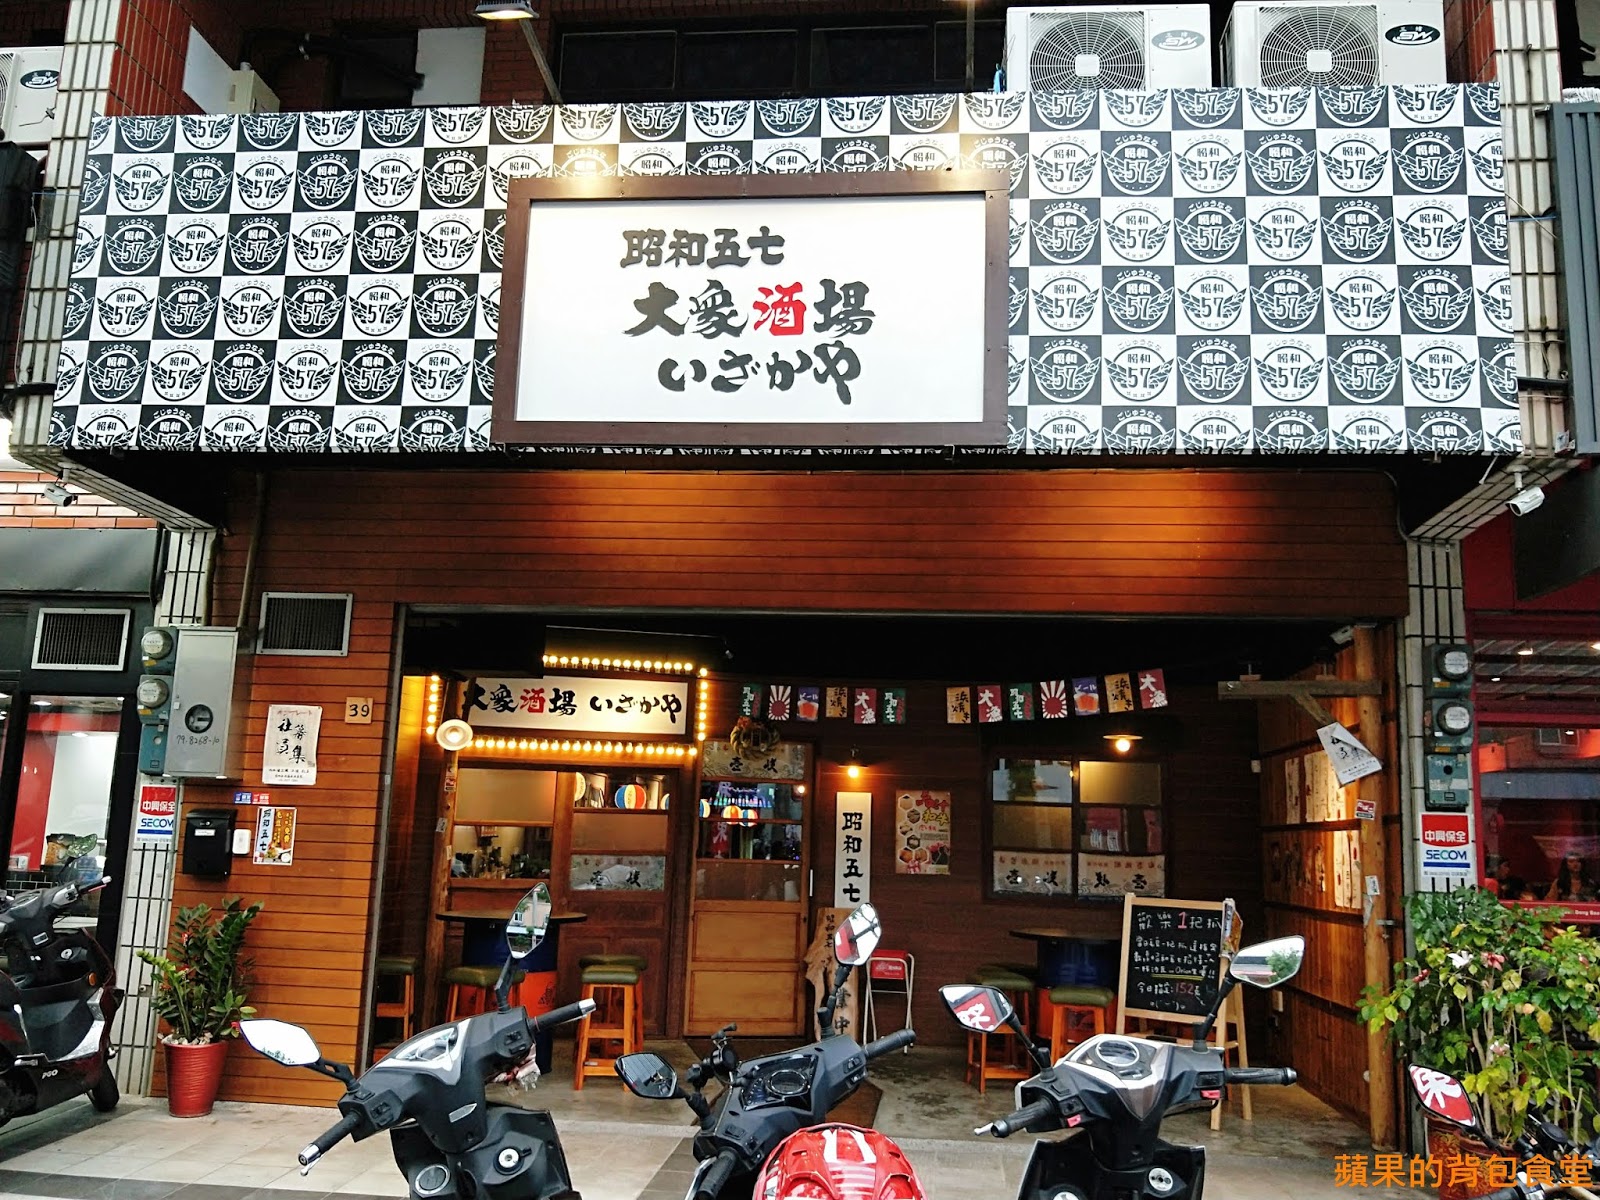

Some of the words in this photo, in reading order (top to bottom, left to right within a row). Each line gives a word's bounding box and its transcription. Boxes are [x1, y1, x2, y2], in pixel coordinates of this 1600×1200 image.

[643, 107, 665, 128] 57
[710, 107, 731, 126] 57
[777, 102, 799, 124] 57
[845, 101, 867, 121] 57
[914, 98, 936, 120] 57
[983, 98, 1005, 118] 57
[512, 110, 533, 131] 57
[577, 110, 598, 129] 57
[1054, 149, 1076, 159] 昭和
[1125, 148, 1148, 158] 昭和
[1197, 148, 1220, 157] 昭和
[1269, 146, 1293, 157] 昭和
[1343, 147, 1366, 157] 昭和
[1416, 145, 1440, 156] 昭和
[133, 170, 152, 179] 昭和
[193, 169, 214, 178] 昭和
[255, 168, 275, 177] 昭和
[317, 166, 338, 176] 昭和
[381, 165, 401, 174] 昭和
[444, 163, 465, 173] 昭和
[1054, 162, 1076, 182] 57
[1125, 160, 1149, 182] 57
[1197, 160, 1220, 181] 57
[1270, 158, 1294, 181] 57
[1343, 159, 1367, 180] 57
[1417, 157, 1442, 180] 57
[130, 181, 150, 200] 57
[191, 180, 212, 200] 57
[253, 180, 273, 198] 57
[316, 177, 337, 198] 57
[379, 177, 400, 196] 57
[443, 174, 464, 195] 57
[1053, 215, 1077, 226] 昭和
[1126, 215, 1149, 225] 昭和
[1198, 214, 1222, 225] 昭和
[1272, 214, 1295, 224] 昭和
[1345, 213, 1369, 224] 昭和
[1420, 213, 1443, 224] 昭和
[124, 231, 144, 241] 昭和
[186, 230, 206, 239] 昭和
[248, 229, 269, 239] 昭和
[311, 229, 331, 238] 昭和
[374, 227, 396, 237] 昭和
[440, 227, 461, 236] 昭和
[1054, 228, 1077, 250] 57
[1126, 228, 1149, 249] 57
[1199, 227, 1223, 250] 57
[1272, 227, 1296, 248] 57
[1346, 226, 1370, 249] 57
[1421, 227, 1445, 247] 57
[122, 242, 143, 263] 57
[184, 242, 204, 261] 57
[246, 241, 267, 262] 57
[309, 241, 330, 260] 57
[373, 239, 395, 260] 57
[438, 239, 460, 258] 57
[619, 225, 785, 269] 昭和五七
[178, 292, 199, 303] 昭和
[241, 293, 261, 302] 昭和
[303, 292, 325, 302] 昭和
[369, 292, 390, 301] 昭和
[434, 291, 456, 301] 昭和
[1054, 285, 1077, 295] 昭和
[1126, 283, 1150, 294] 昭和
[1201, 284, 1224, 294] 昭和
[1274, 283, 1299, 294] 昭和
[1350, 283, 1373, 293] 昭和
[1423, 282, 1449, 294] 昭和
[116, 293, 136, 303] 昭和
[1127, 296, 1151, 319] 57
[1201, 297, 1225, 318] 57
[1275, 296, 1300, 319] 57
[1350, 297, 1374, 318] 57
[1425, 295, 1450, 319] 57
[114, 306, 134, 325] 57
[176, 304, 197, 325] 57
[239, 305, 259, 324] 57
[302, 303, 324, 325] 57
[367, 304, 389, 324] 57
[433, 302, 455, 324] 57
[622, 278, 876, 340] 大衆酒場
[1054, 298, 1077, 319] 57
[106, 357, 127, 367] 昭和
[169, 357, 189, 367] 昭和
[232, 356, 254, 367] 昭和
[297, 357, 318, 366] 昭和
[362, 356, 384, 367] 昭和
[429, 356, 450, 366] 昭和
[1053, 353, 1077, 364] 昭和
[1128, 354, 1151, 364] 昭和
[1201, 353, 1226, 364] 昭和
[1277, 353, 1301, 364] 昭和
[1352, 353, 1377, 364] 昭和
[1429, 354, 1453, 364] 昭和
[104, 368, 125, 390] 57
[167, 369, 188, 389] 57
[231, 368, 252, 390] 57
[295, 369, 316, 389] 57
[361, 368, 383, 390] 57
[427, 369, 449, 389] 57
[658, 340, 861, 405] いざかや
[1054, 366, 1078, 389] 57
[1128, 367, 1151, 388] 57
[1202, 365, 1227, 389] 57
[1278, 367, 1302, 388] 57
[1353, 366, 1378, 390] 57
[1430, 368, 1454, 389] 57
[1075, 684, 1097, 693] ビール
[1139, 674, 1168, 708] 大漁
[349, 704, 370, 717] 39
[462, 682, 577, 717] 大衆酒場
[590, 693, 682, 724] いざかや
[854, 692, 876, 724] 大漁
[978, 689, 1003, 723] 大漁
[142, 800, 175, 812] 中興保全
[1424, 829, 1466, 843] 中興保全
[842, 812, 863, 903] 昭和五七
[1426, 849, 1467, 861] SECOM
[42, 1069, 59, 1080] PGO
